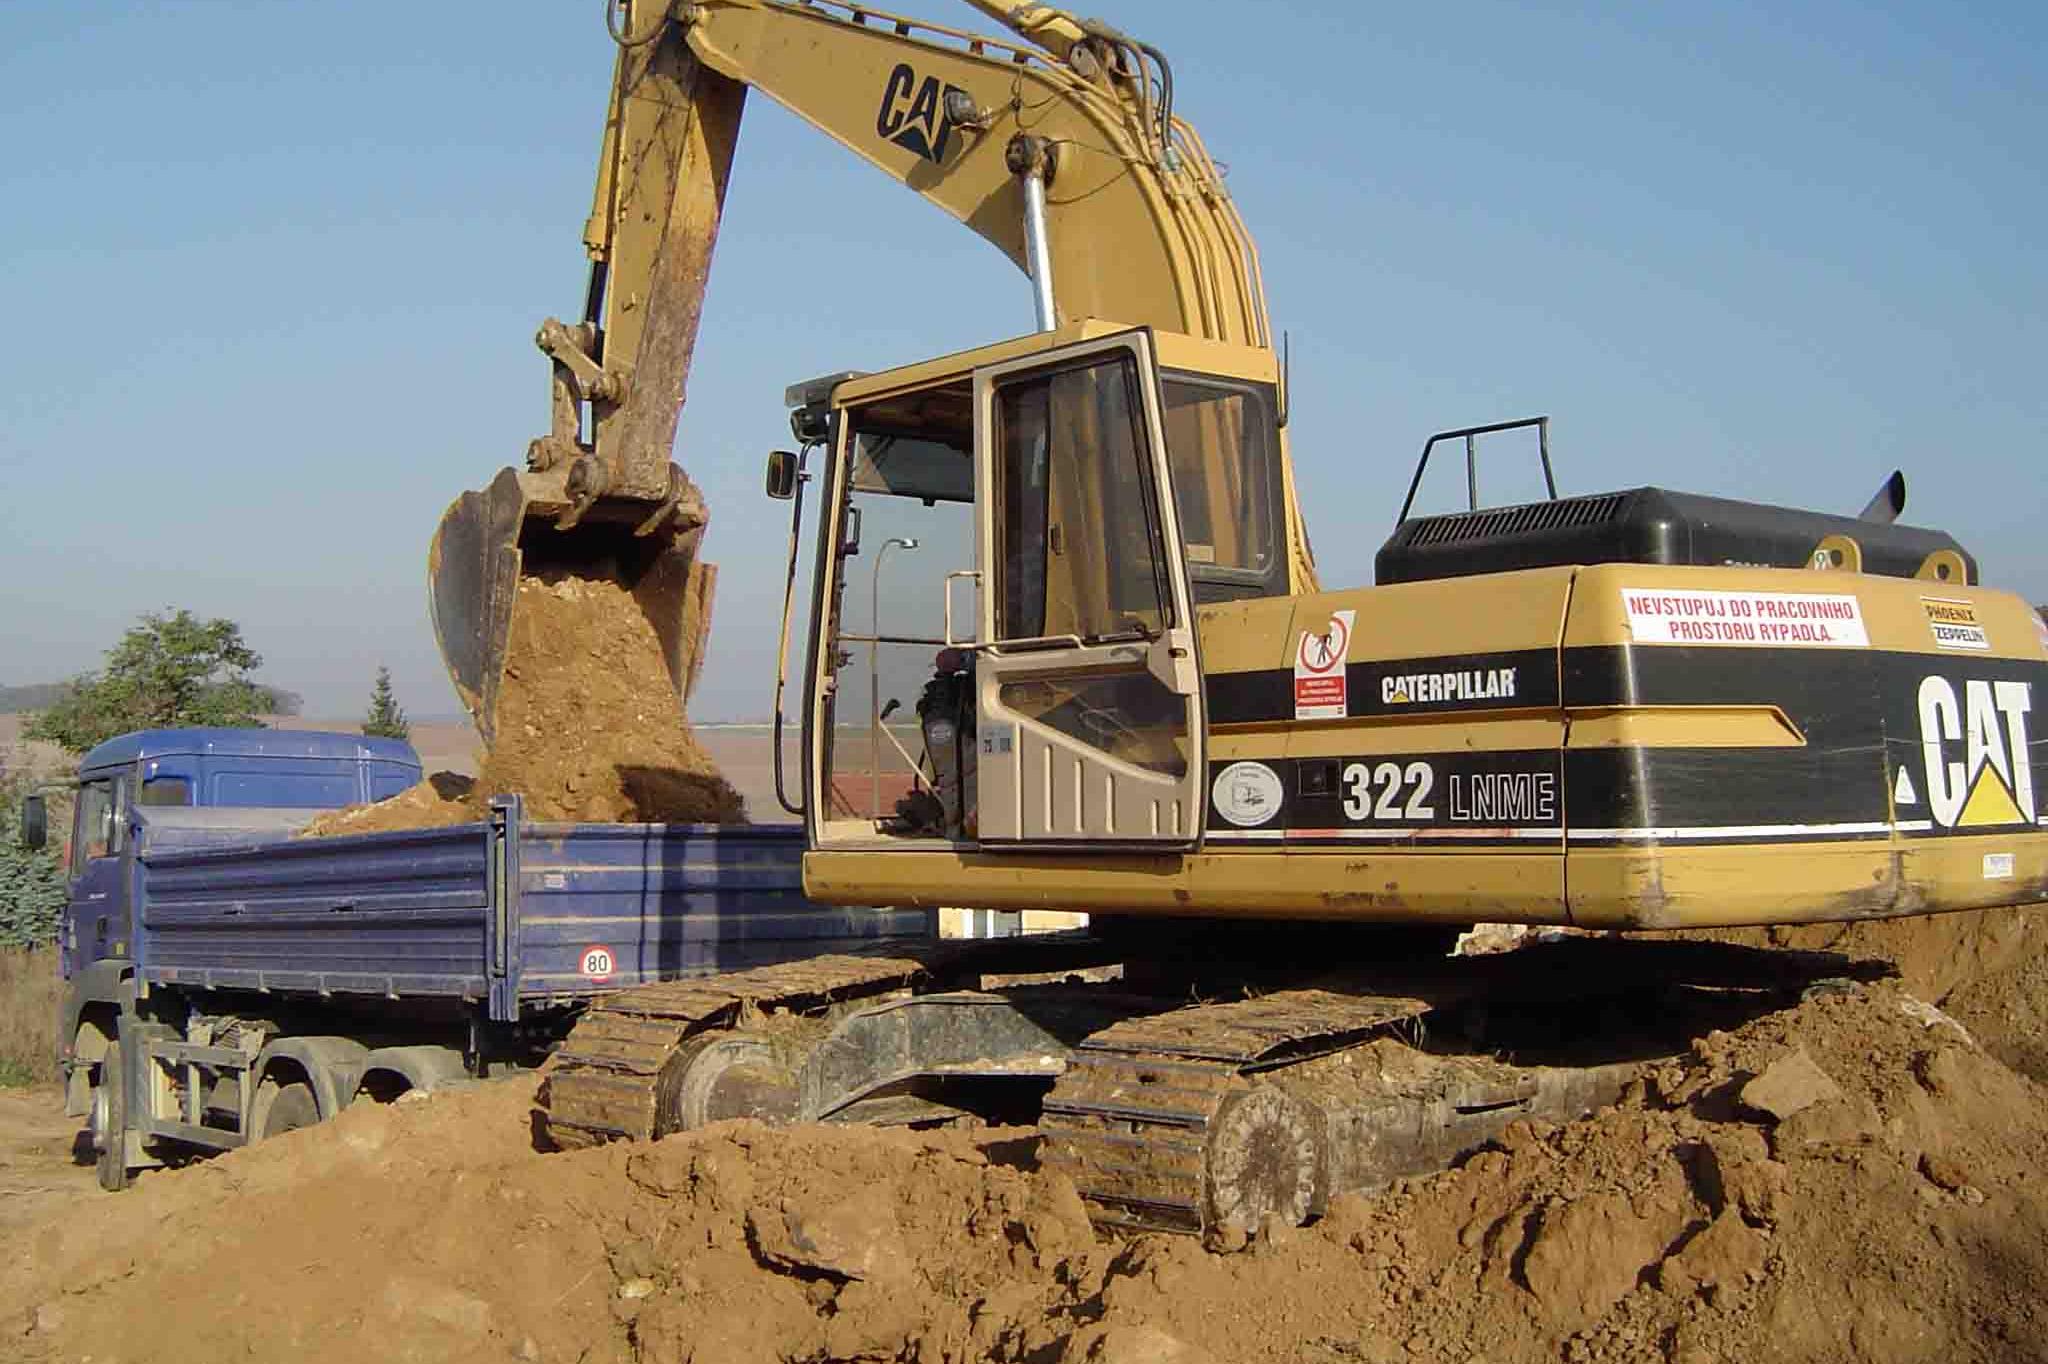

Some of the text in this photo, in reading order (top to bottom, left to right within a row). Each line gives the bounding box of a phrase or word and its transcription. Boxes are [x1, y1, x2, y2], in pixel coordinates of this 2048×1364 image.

[1629, 596, 1726, 617] NEVSTUPUJ
[1728, 599, 1752, 617] DO
[1668, 620, 1755, 640] PROSTORU
[1381, 668, 1516, 704] CATERPILLAR
[1918, 675, 2036, 828] CAT
[1343, 762, 1555, 821] 322 LNME
[587, 954, 608, 973] 80
